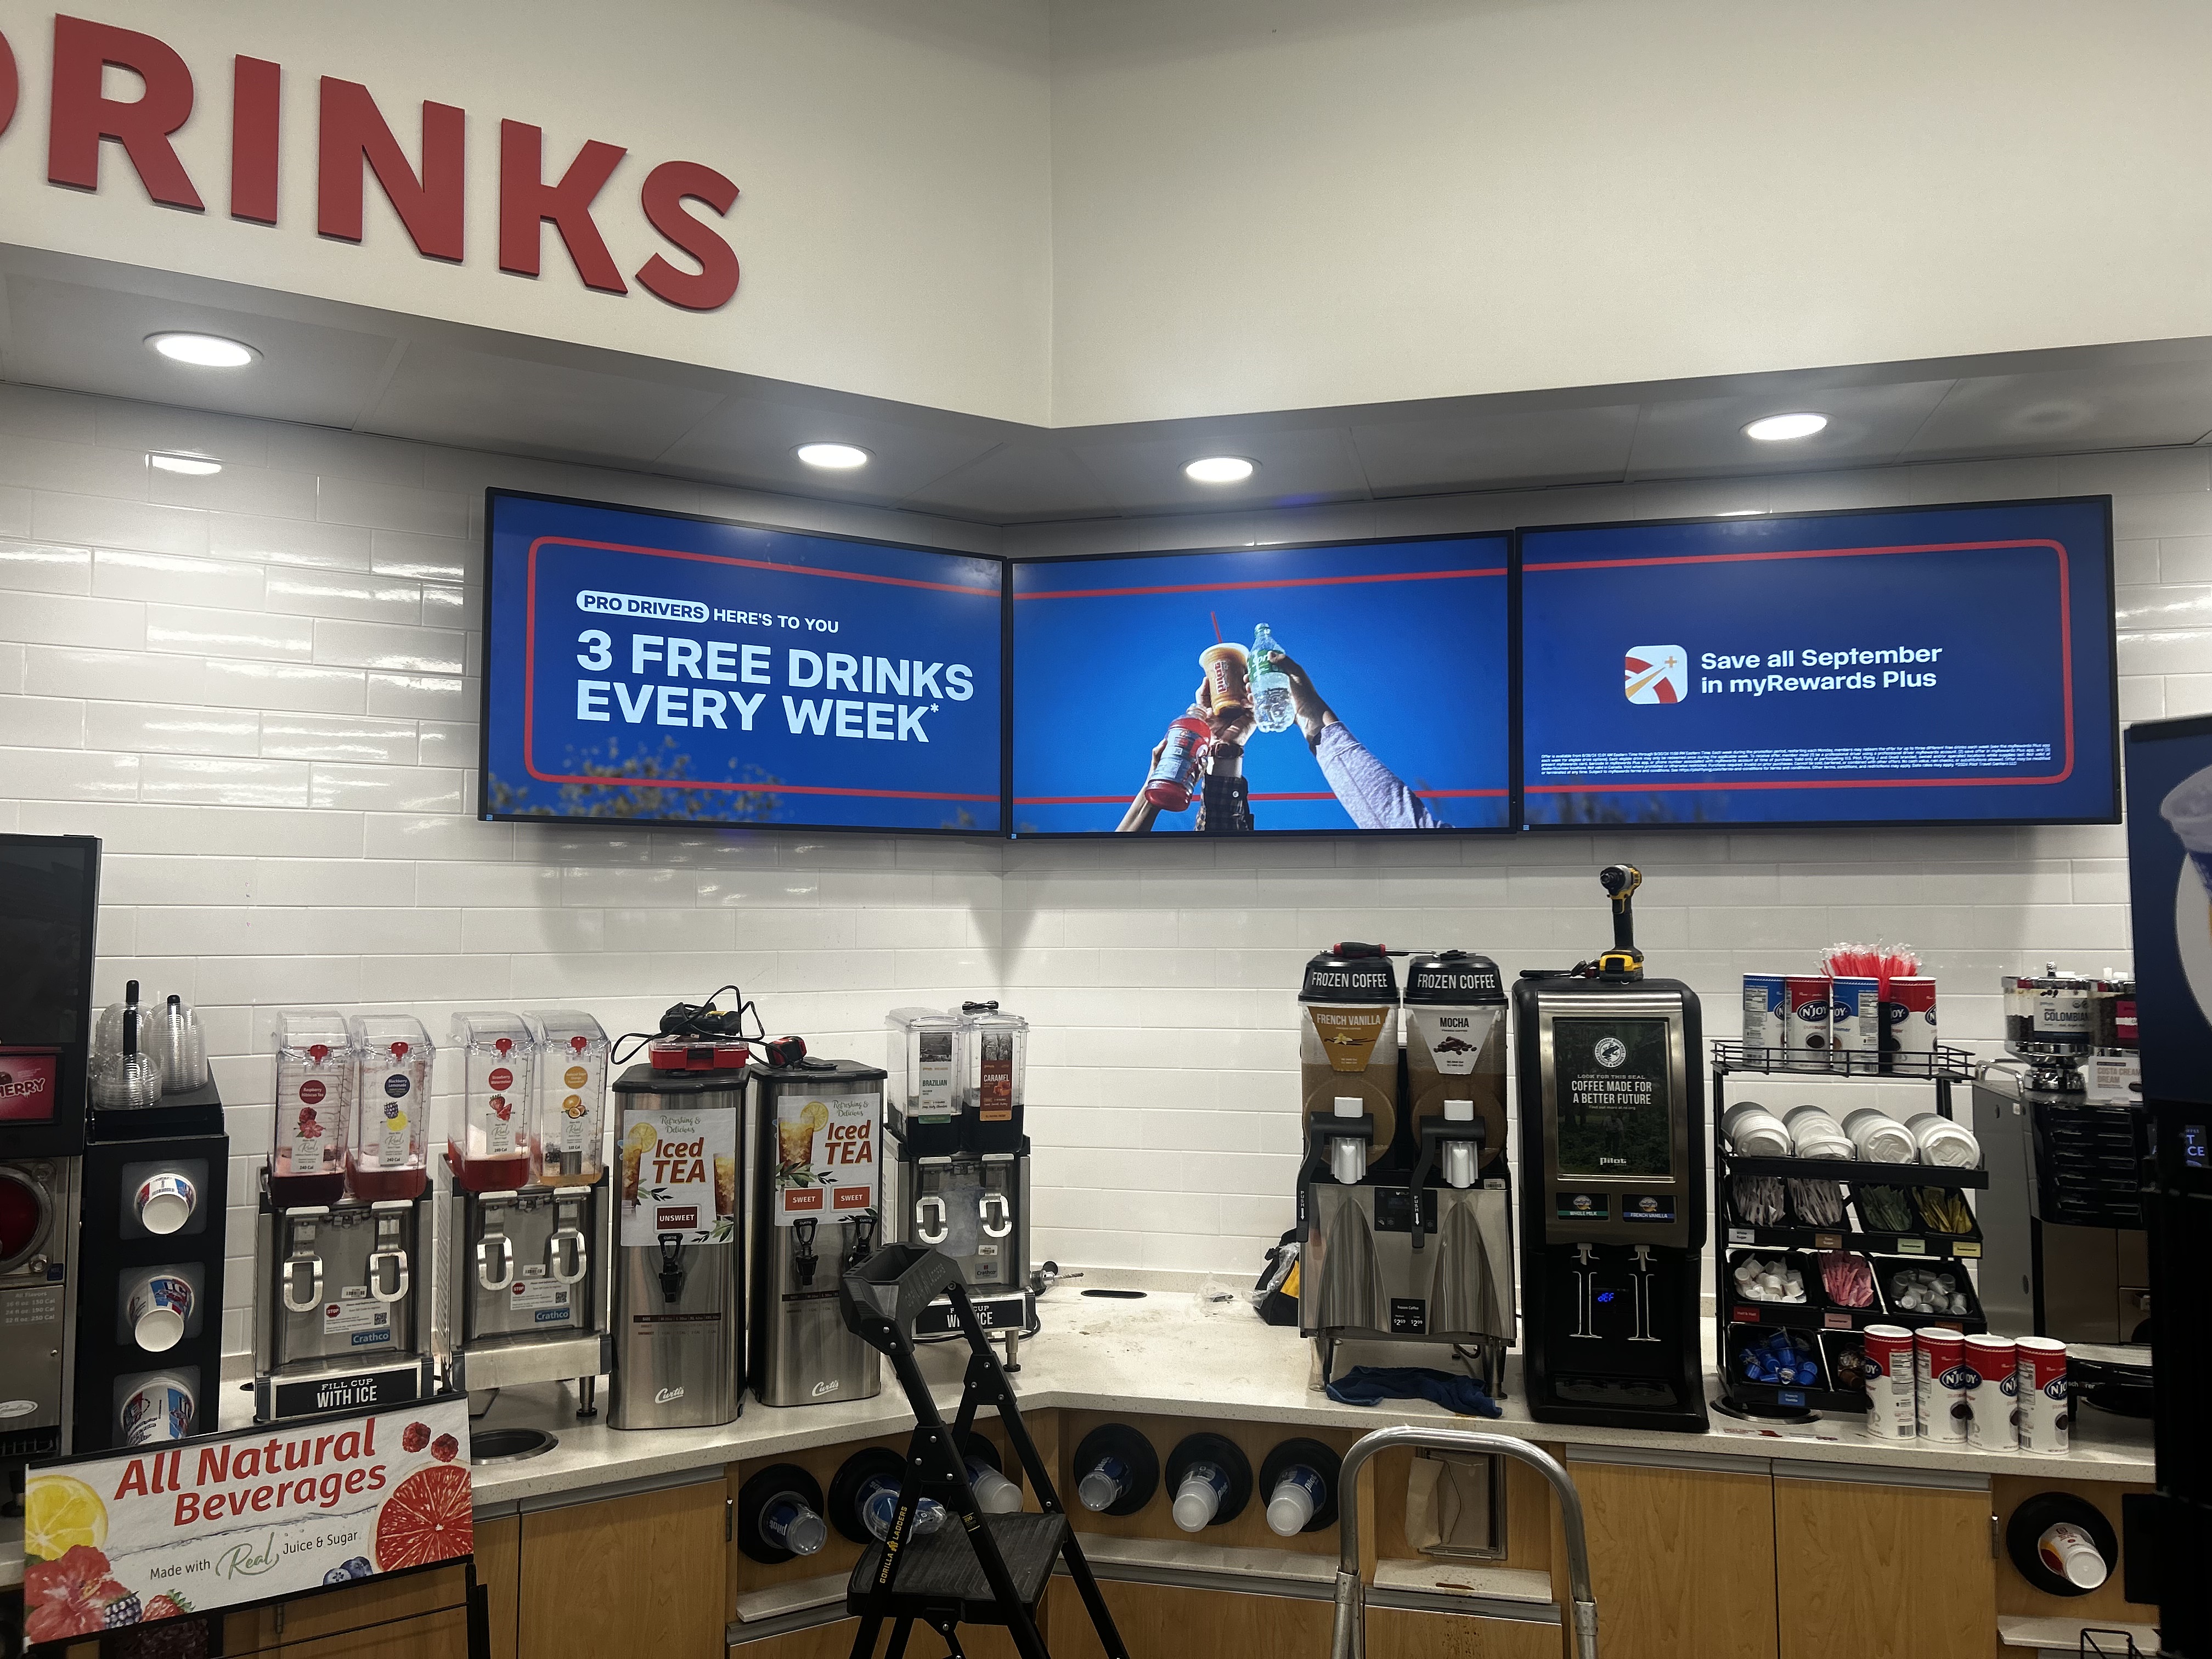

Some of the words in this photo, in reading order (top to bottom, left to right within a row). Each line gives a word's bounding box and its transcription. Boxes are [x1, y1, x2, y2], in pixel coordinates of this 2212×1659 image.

[0, 14, 741, 311] RINKS
[583, 595, 622, 613] PRO
[627, 599, 704, 620] DRIVERS
[714, 607, 772, 627] HERE'S
[777, 614, 800, 629] TO
[804, 617, 839, 634] YOU
[577, 629, 613, 672] 3
[632, 634, 771, 685] FREE
[788, 650, 974, 702] DRINKS
[1701, 652, 1760, 670] Save
[1767, 650, 1795, 667] all
[1802, 646, 1943, 670] September
[1701, 676, 1723, 693] in
[1729, 672, 1876, 697] myRewards
[1883, 670, 1937, 688] Plus
[577, 679, 766, 731] EVERY
[1312, 972, 1349, 988] FROZEN
[1352, 974, 1388, 988] COFFEE
[1418, 974, 1457, 989] FROZEN
[1460, 974, 1496, 989] COFFEE
[1317, 1014, 1346, 1025] FRENCH
[1348, 1015, 1381, 1025] VANILLA
[1440, 1018, 1470, 1028] MOCHA
[984, 1074, 1010, 1082] CARAMEL
[1572, 1081, 1605, 1091] COFFEE
[1607, 1081, 1632, 1092] MADE
[1635, 1081, 1652, 1092] FOR
[833, 1100, 862, 1109] Refreshing
[1573, 1093, 1579, 1103] A
[1582, 1093, 1615, 1104] BETTER
[1617, 1094, 1651, 1104] FUTURE
[660, 1115, 693, 1126] Refreshing
[827, 1120, 871, 1141] Iced
[656, 1137, 704, 1158] Iced
[825, 1141, 872, 1165] TEA
[653, 1160, 706, 1184] TEA
[537, 1310, 568, 1320] Crathco
[353, 1333, 389, 1343] Crathco
[321, 1382, 348, 1391] FILL
[351, 1379, 374, 1387] CUP
[655, 1387, 684, 1403] Curtis
[812, 1380, 839, 1397] Curtis
[317, 1389, 352, 1408] WITH
[356, 1386, 377, 1403] ICE
[115, 1451, 181, 1500] All
[197, 1418, 376, 1487] Natural
[1305, 1474, 1318, 1493] pilot
[174, 1465, 387, 1527] Beverages
[879, 1553, 894, 1584] GORILLA
[892, 1506, 907, 1540] LADDERS
[150, 1565, 182, 1580] Made
[186, 1559, 211, 1573] with
[216, 1532, 280, 1580] Real
[283, 1539, 313, 1555] Juice
[316, 1536, 324, 1548] &
[327, 1532, 359, 1548] Sugar
